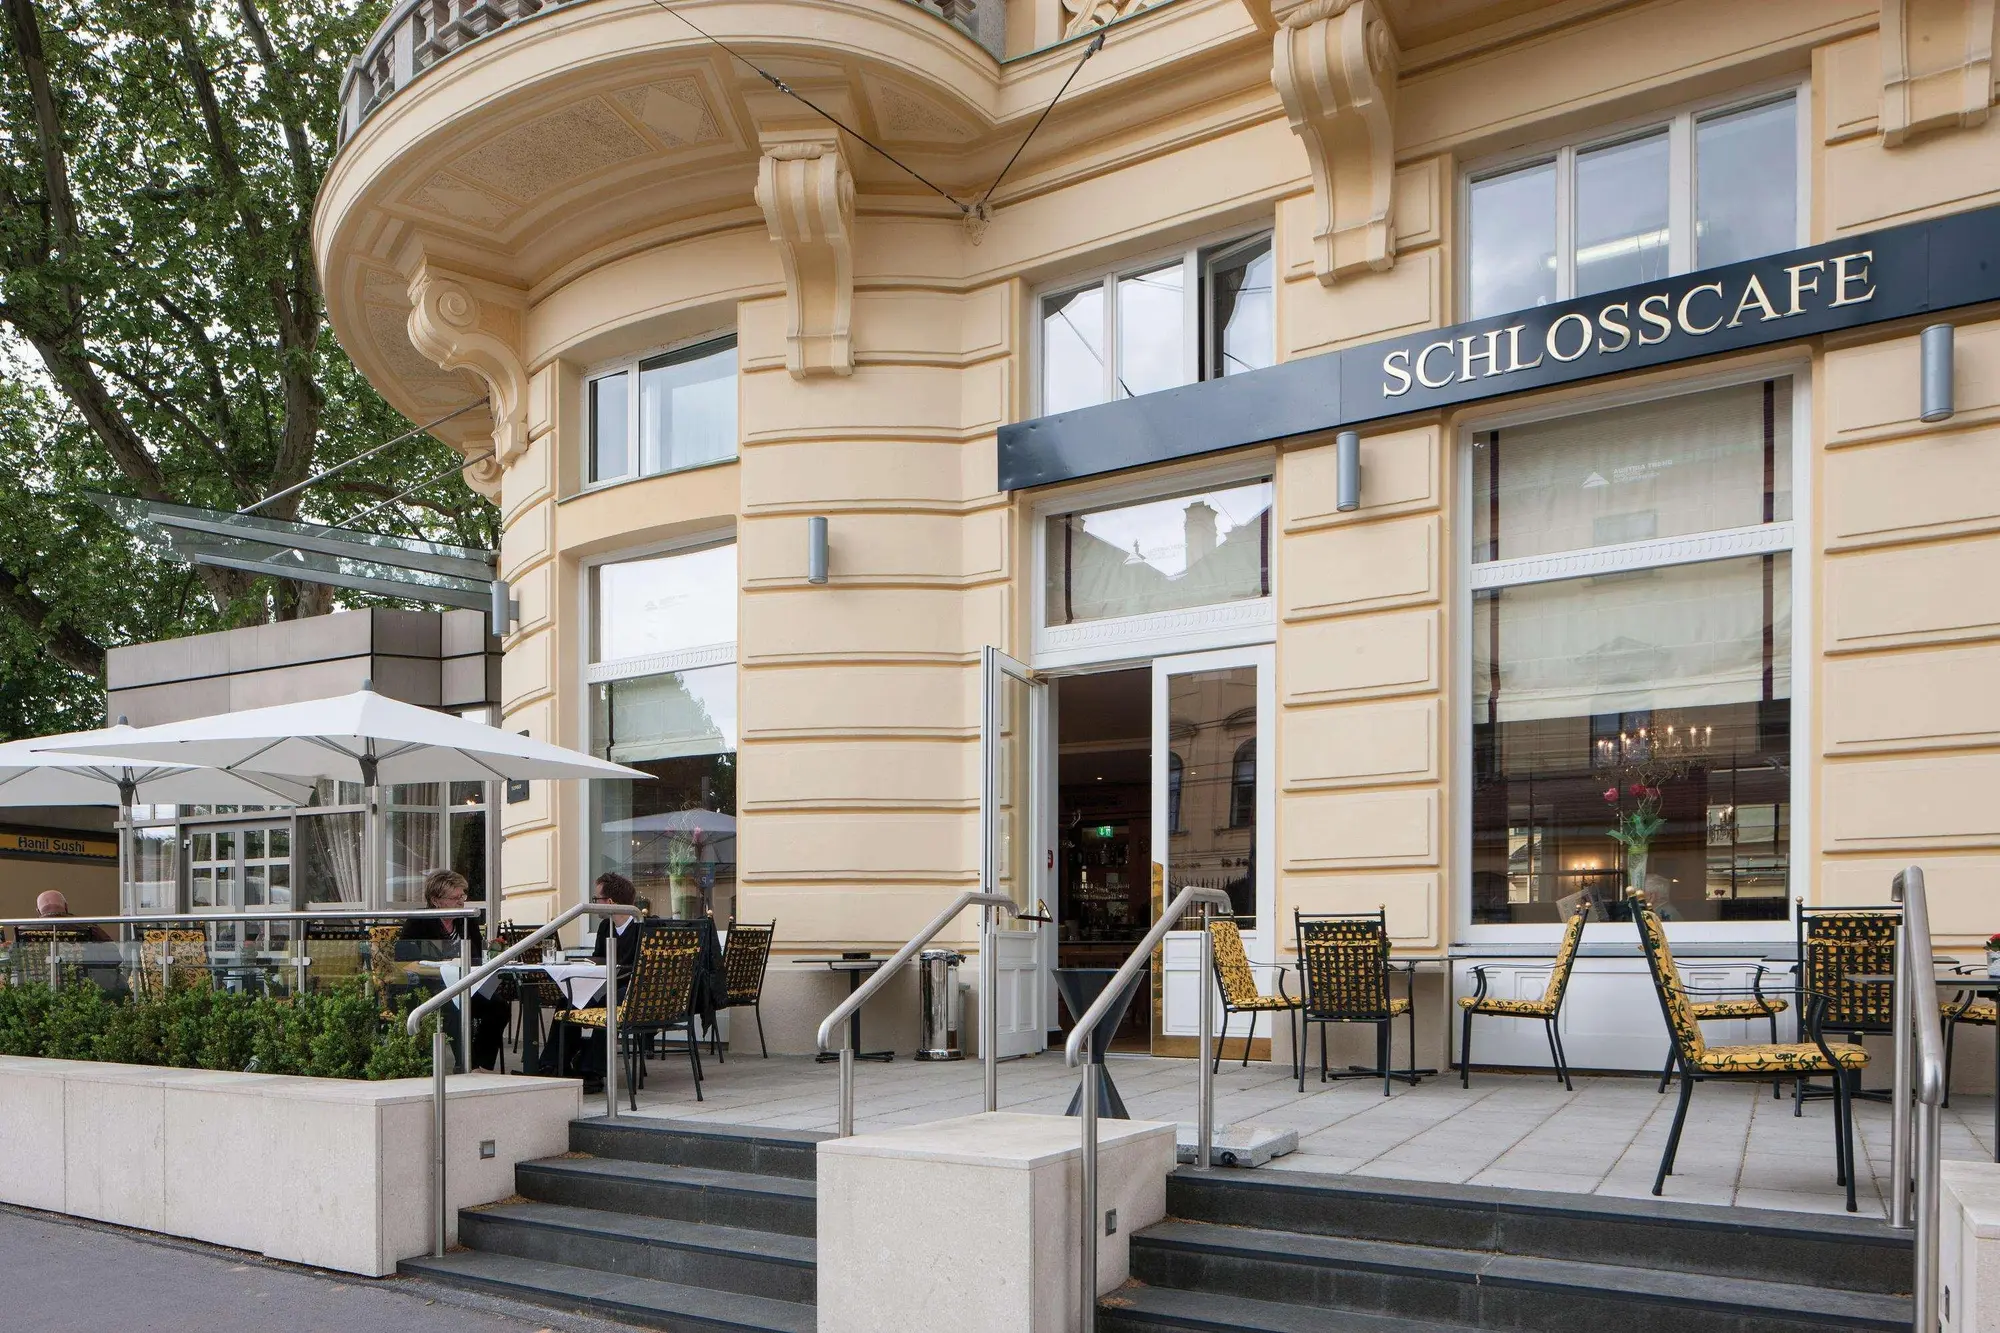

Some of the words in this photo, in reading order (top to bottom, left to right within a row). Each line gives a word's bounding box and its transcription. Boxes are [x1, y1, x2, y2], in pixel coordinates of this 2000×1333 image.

[1382, 250, 1877, 398] SCHLOSSCAFE
[18, 836, 49, 850] Hanil
[52, 839, 86, 853] Sushi
